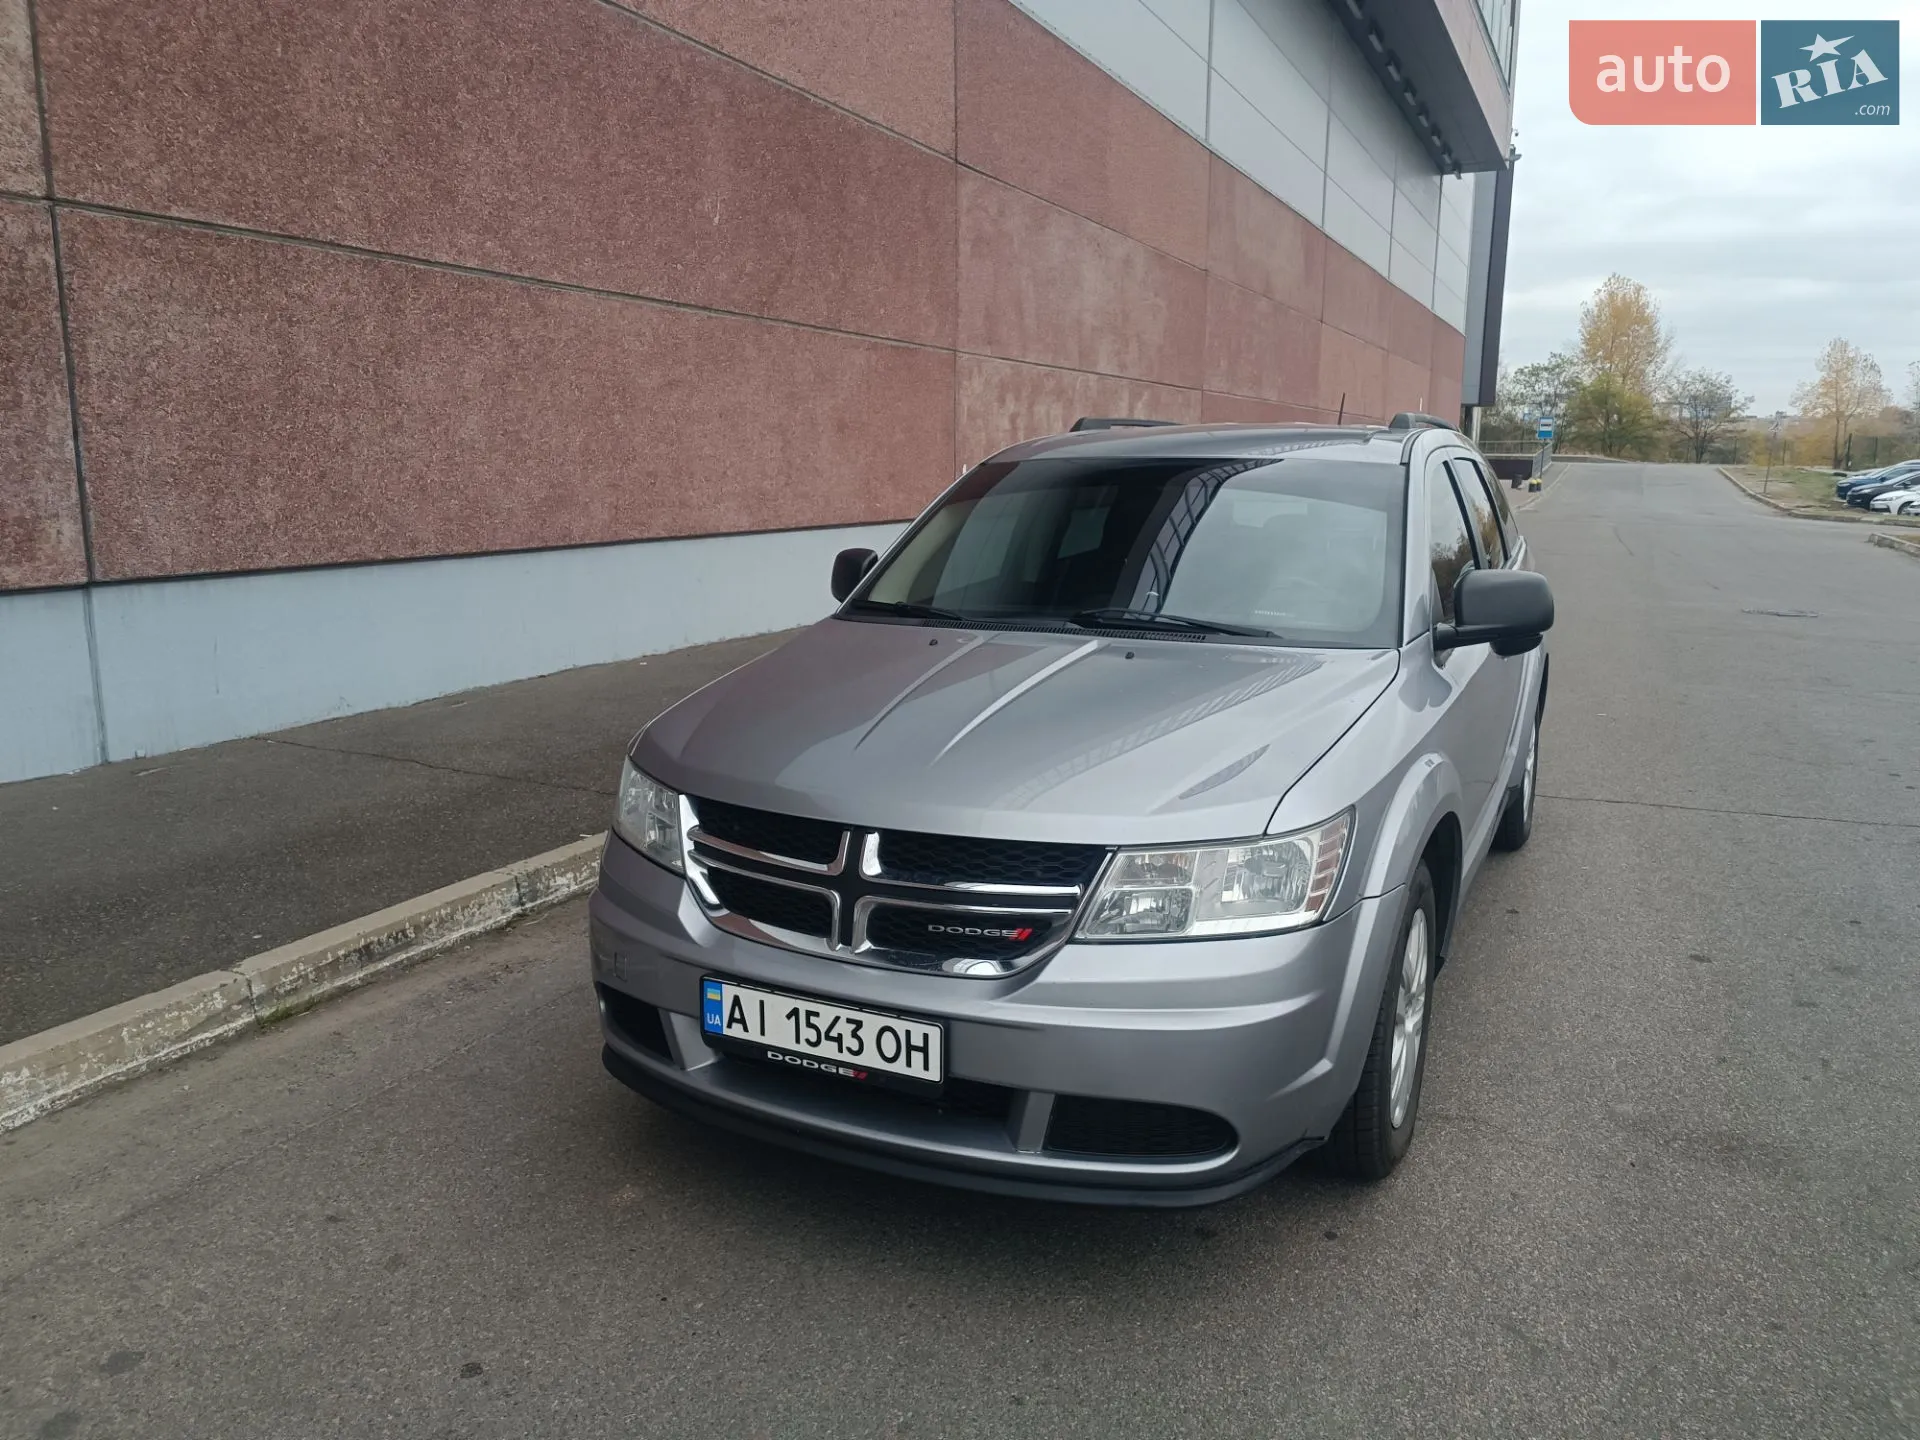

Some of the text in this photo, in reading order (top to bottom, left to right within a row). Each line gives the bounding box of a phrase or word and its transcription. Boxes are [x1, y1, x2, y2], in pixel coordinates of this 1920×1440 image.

[927, 924, 1018, 938] DODGE
[707, 1013, 721, 1026] UA
[785, 1006, 864, 1056] 1543
[876, 1025, 930, 1072] OH
[767, 1050, 855, 1078] DODGE
